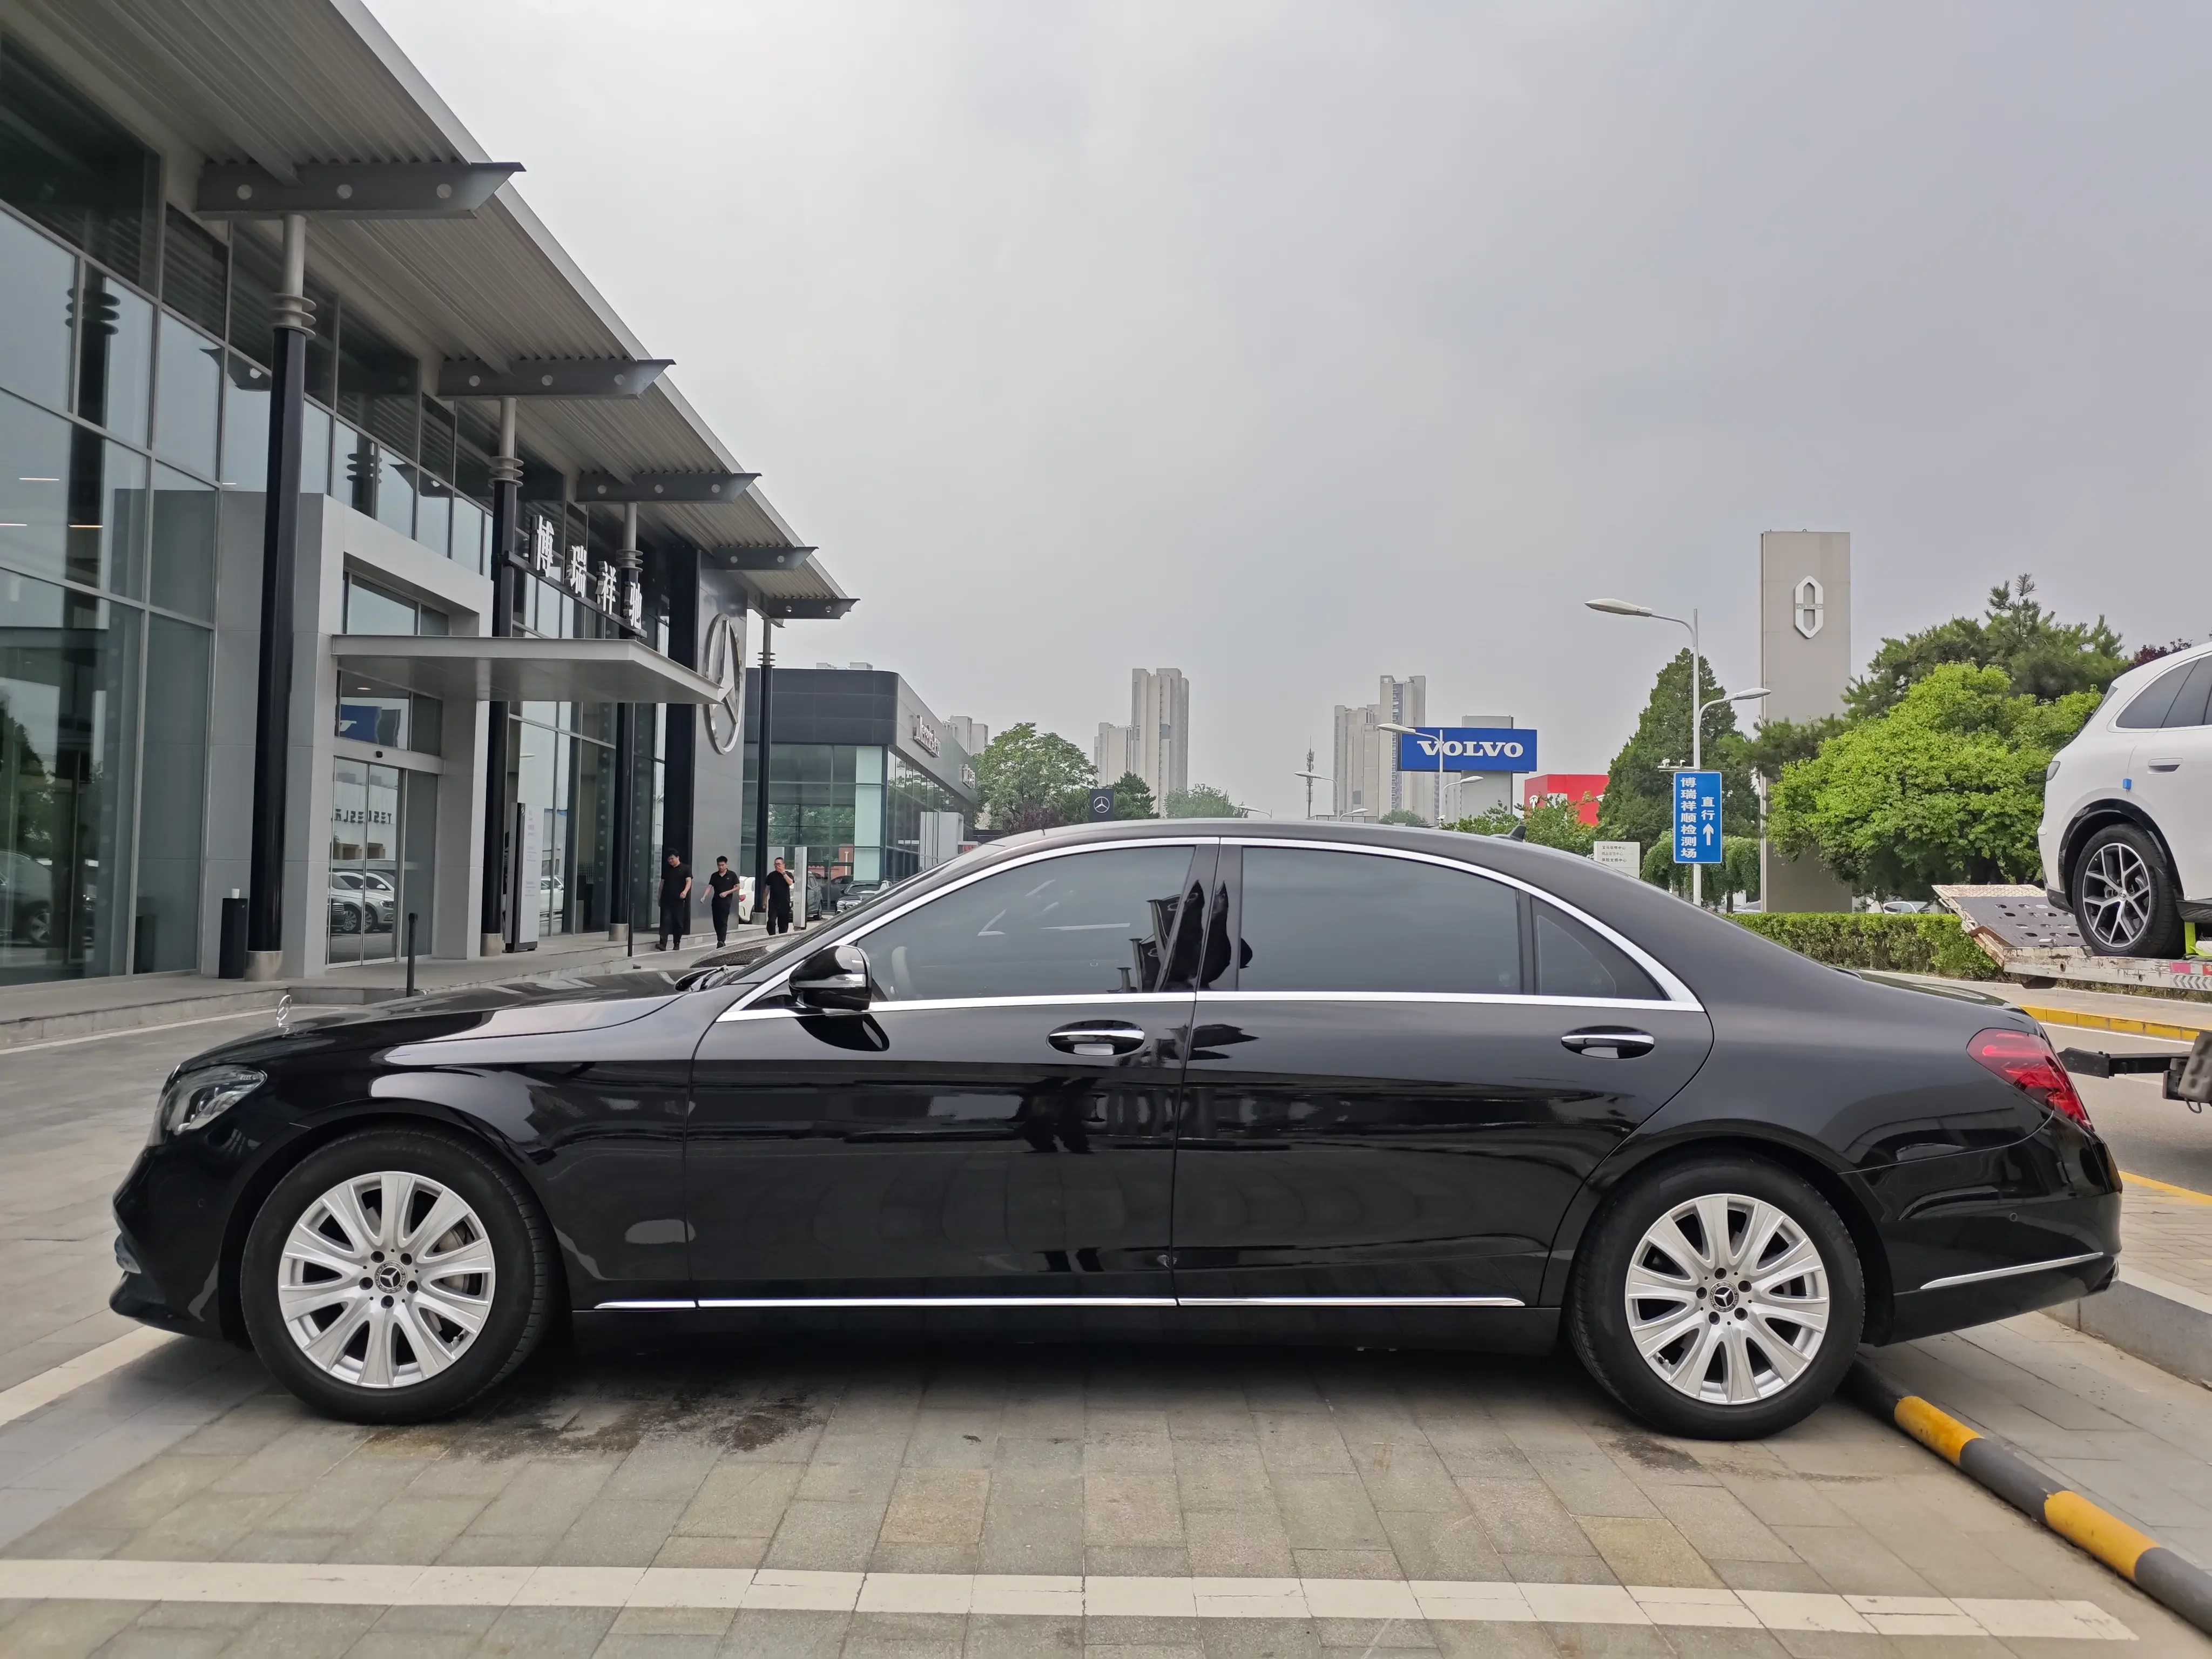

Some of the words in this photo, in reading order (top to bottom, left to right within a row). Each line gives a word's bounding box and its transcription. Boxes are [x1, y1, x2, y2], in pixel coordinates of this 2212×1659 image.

[536, 515, 643, 630] 博瑞祥驰
[1417, 740, 1523, 758] VOLVO
[1680, 777, 1697, 859] 博瑞祥顺检测场
[1701, 796, 1715, 821] 直行
